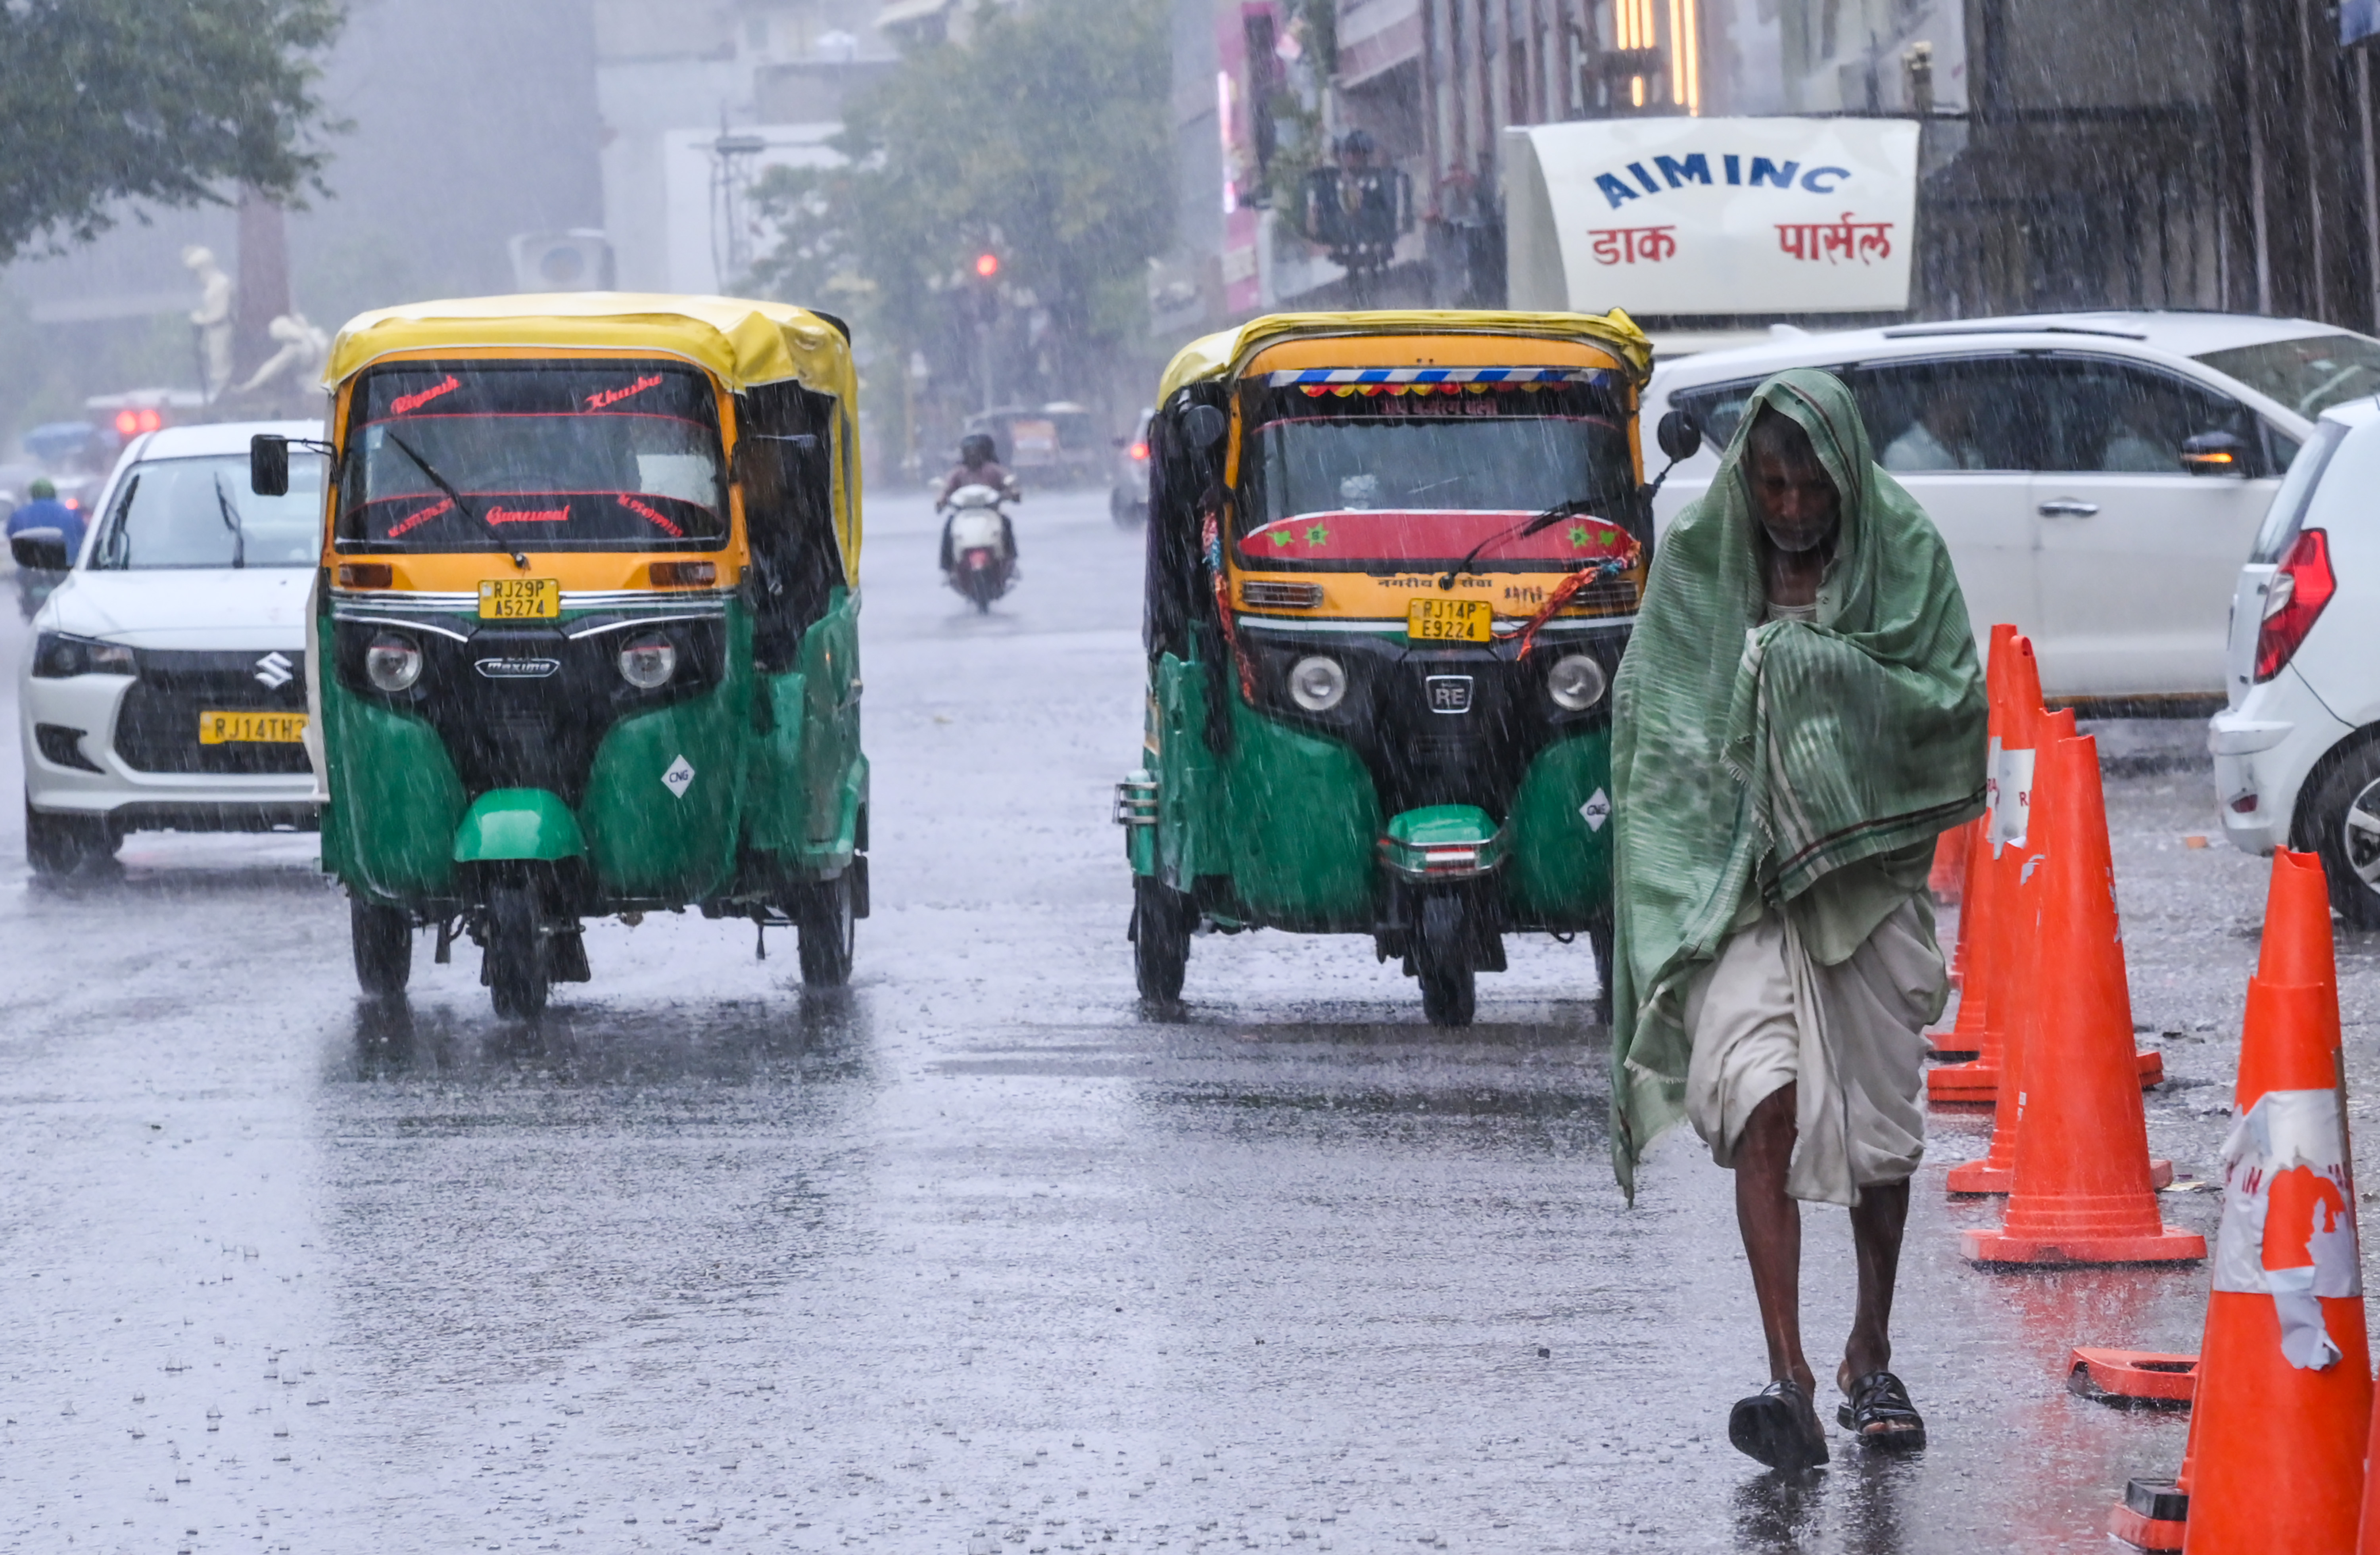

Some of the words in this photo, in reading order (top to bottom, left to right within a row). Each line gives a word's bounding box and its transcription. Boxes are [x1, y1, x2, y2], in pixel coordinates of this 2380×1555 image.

[1588, 225, 1676, 265] डाक
[1774, 212, 1894, 265] पार्सल
[494, 580, 544, 598] RJ29P
[495, 599, 544, 616] A5274
[1424, 601, 1476, 620] RJ14P
[1422, 620, 1474, 638] E9224
[1436, 688, 1465, 705] RE
[669, 770, 689, 783] CNG
